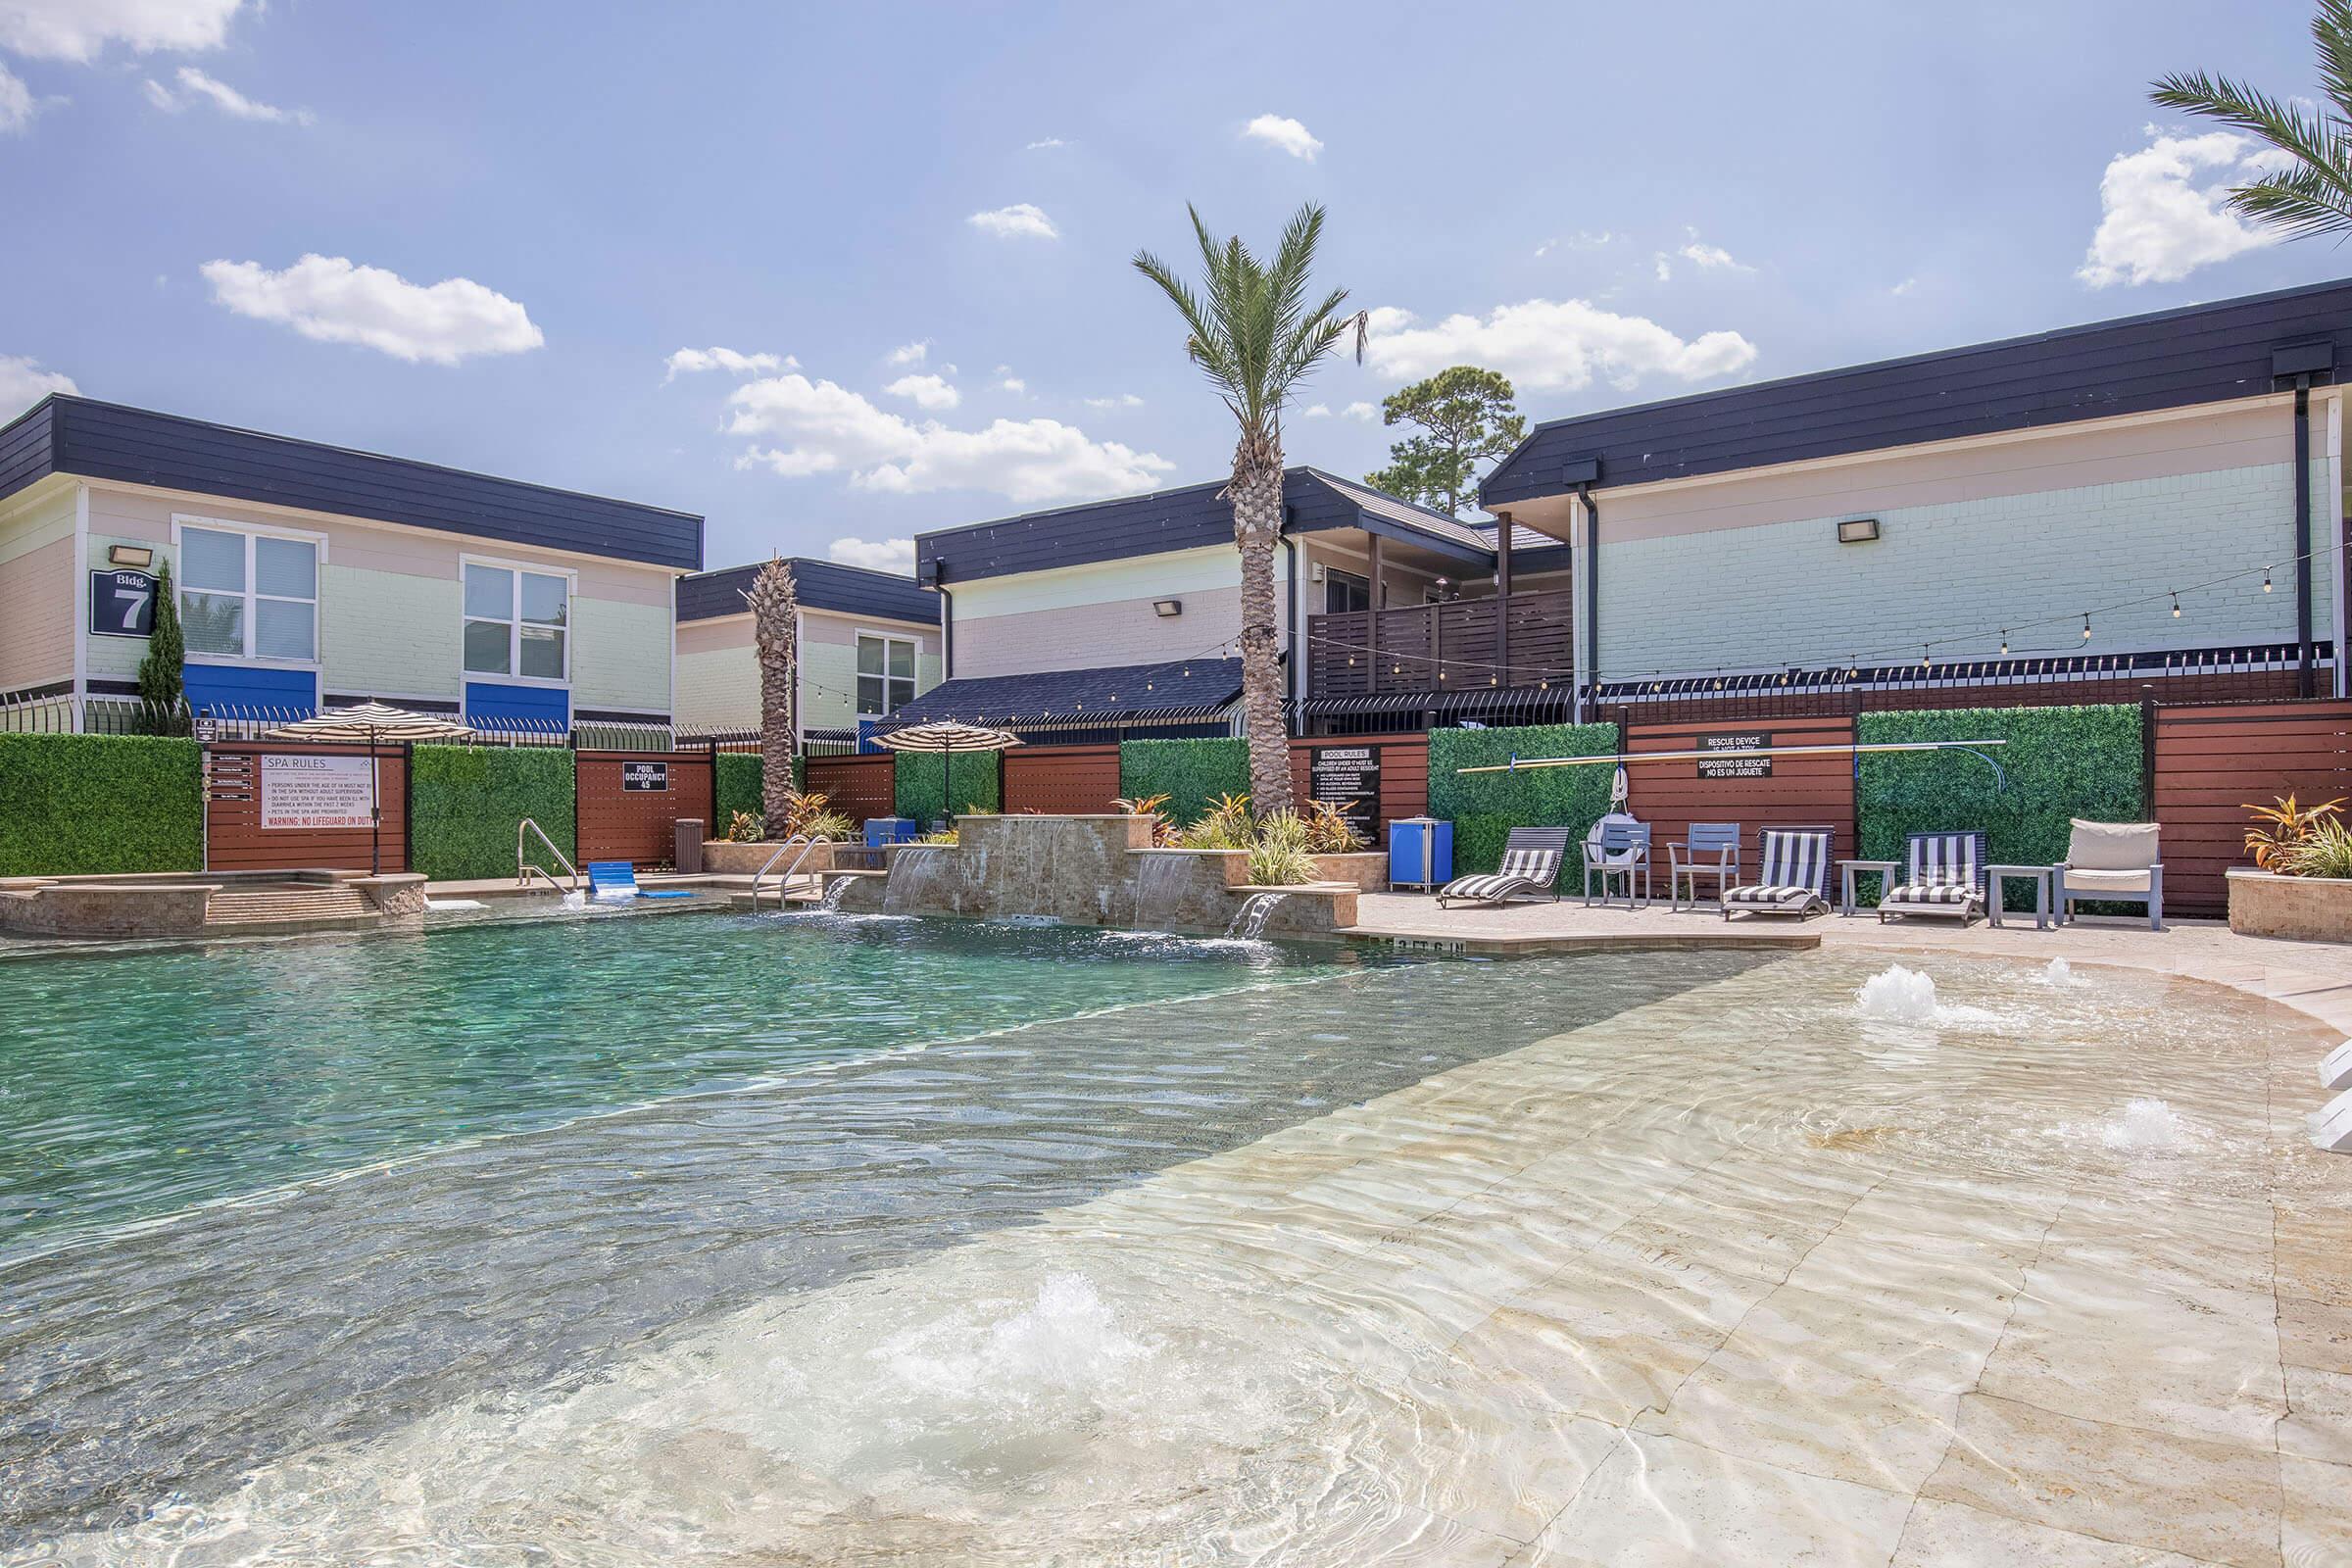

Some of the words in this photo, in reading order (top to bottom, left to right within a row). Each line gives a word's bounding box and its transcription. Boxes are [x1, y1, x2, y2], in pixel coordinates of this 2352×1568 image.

[117, 574, 146, 588] Bldg.
[115, 589, 149, 628] 7
[268, 758, 289, 767] SPA
[292, 759, 326, 768] RULES
[1744, 759, 1771, 767] RESCATE
[268, 817, 301, 826] WARNING:
[302, 816, 312, 825] NO
[313, 816, 346, 825] LIFEGUARD
[348, 816, 356, 825] ON
[1450, 942, 1463, 954] IN
